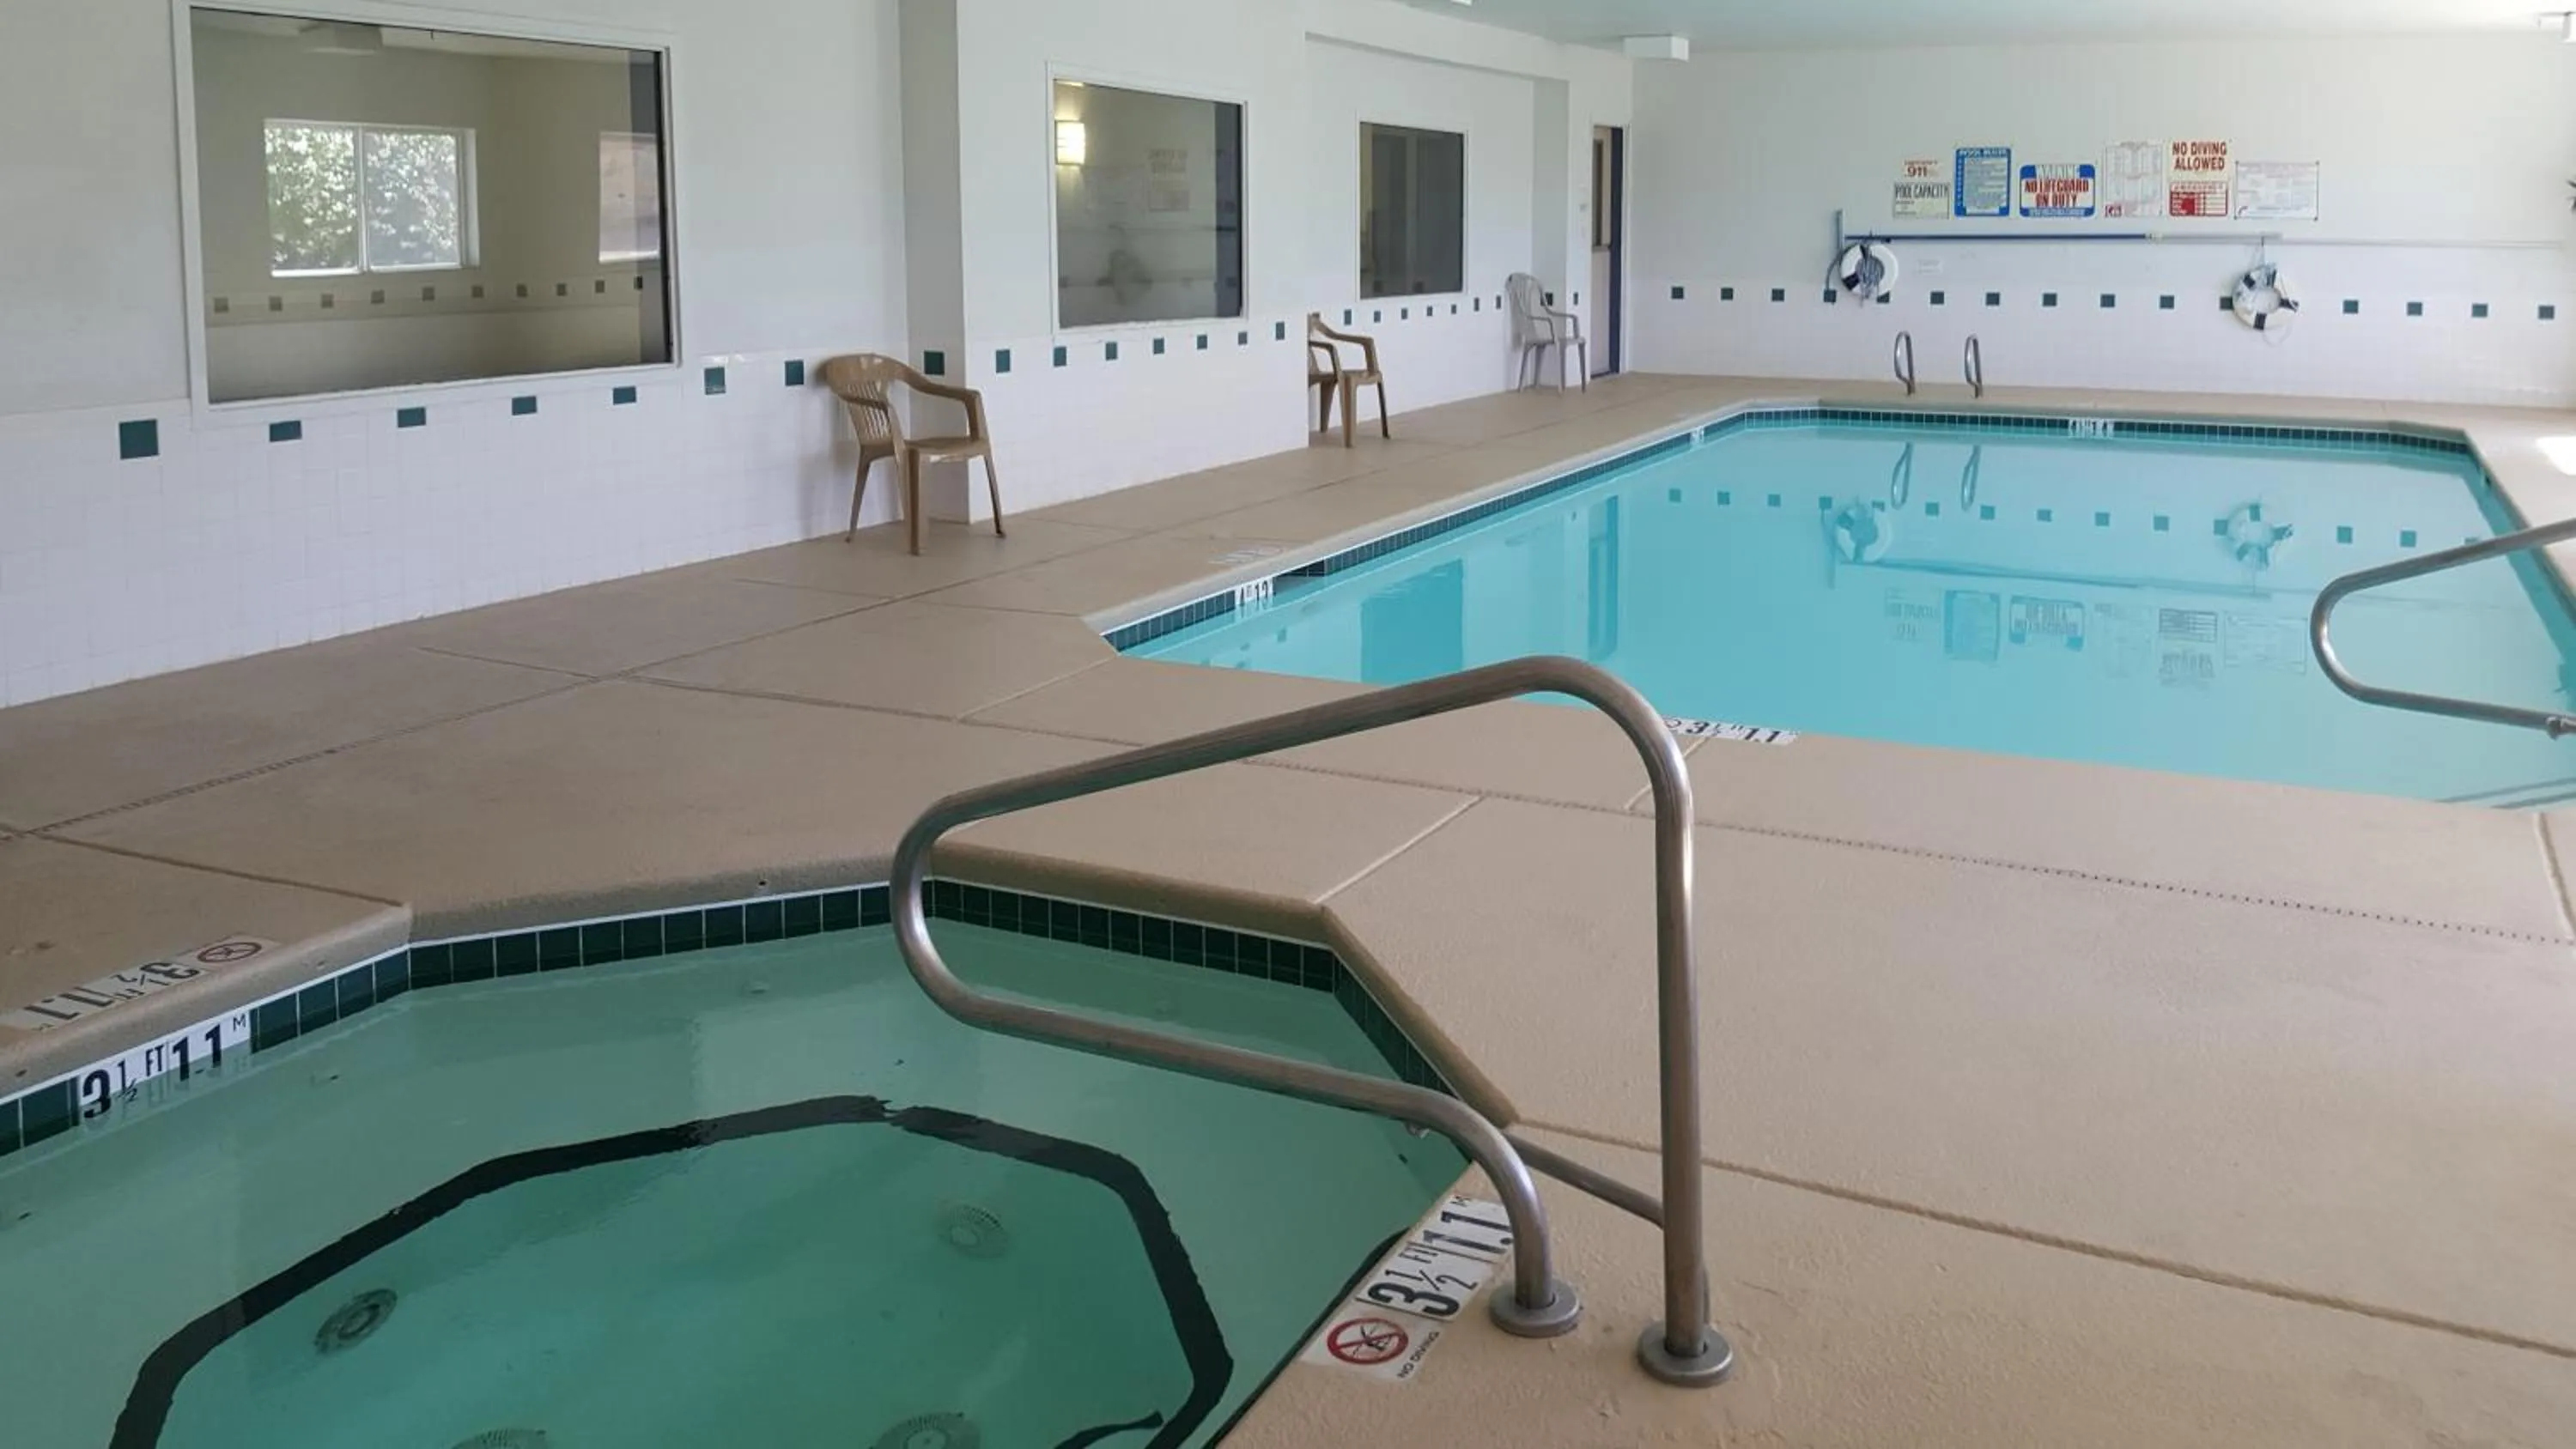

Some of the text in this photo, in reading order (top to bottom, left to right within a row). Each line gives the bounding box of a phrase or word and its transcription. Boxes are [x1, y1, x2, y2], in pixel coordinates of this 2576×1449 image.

[2172, 141, 2227, 155] NO DIVING
[2174, 156, 2225, 171] ALLOWED
[1686, 720, 1710, 734] 3
[82, 1068, 112, 1119] 3
[145, 1044, 164, 1077] FT
[233, 1013, 246, 1032] M
[1367, 1282, 1461, 1317] 3
[1397, 1362, 1415, 1378] NO
